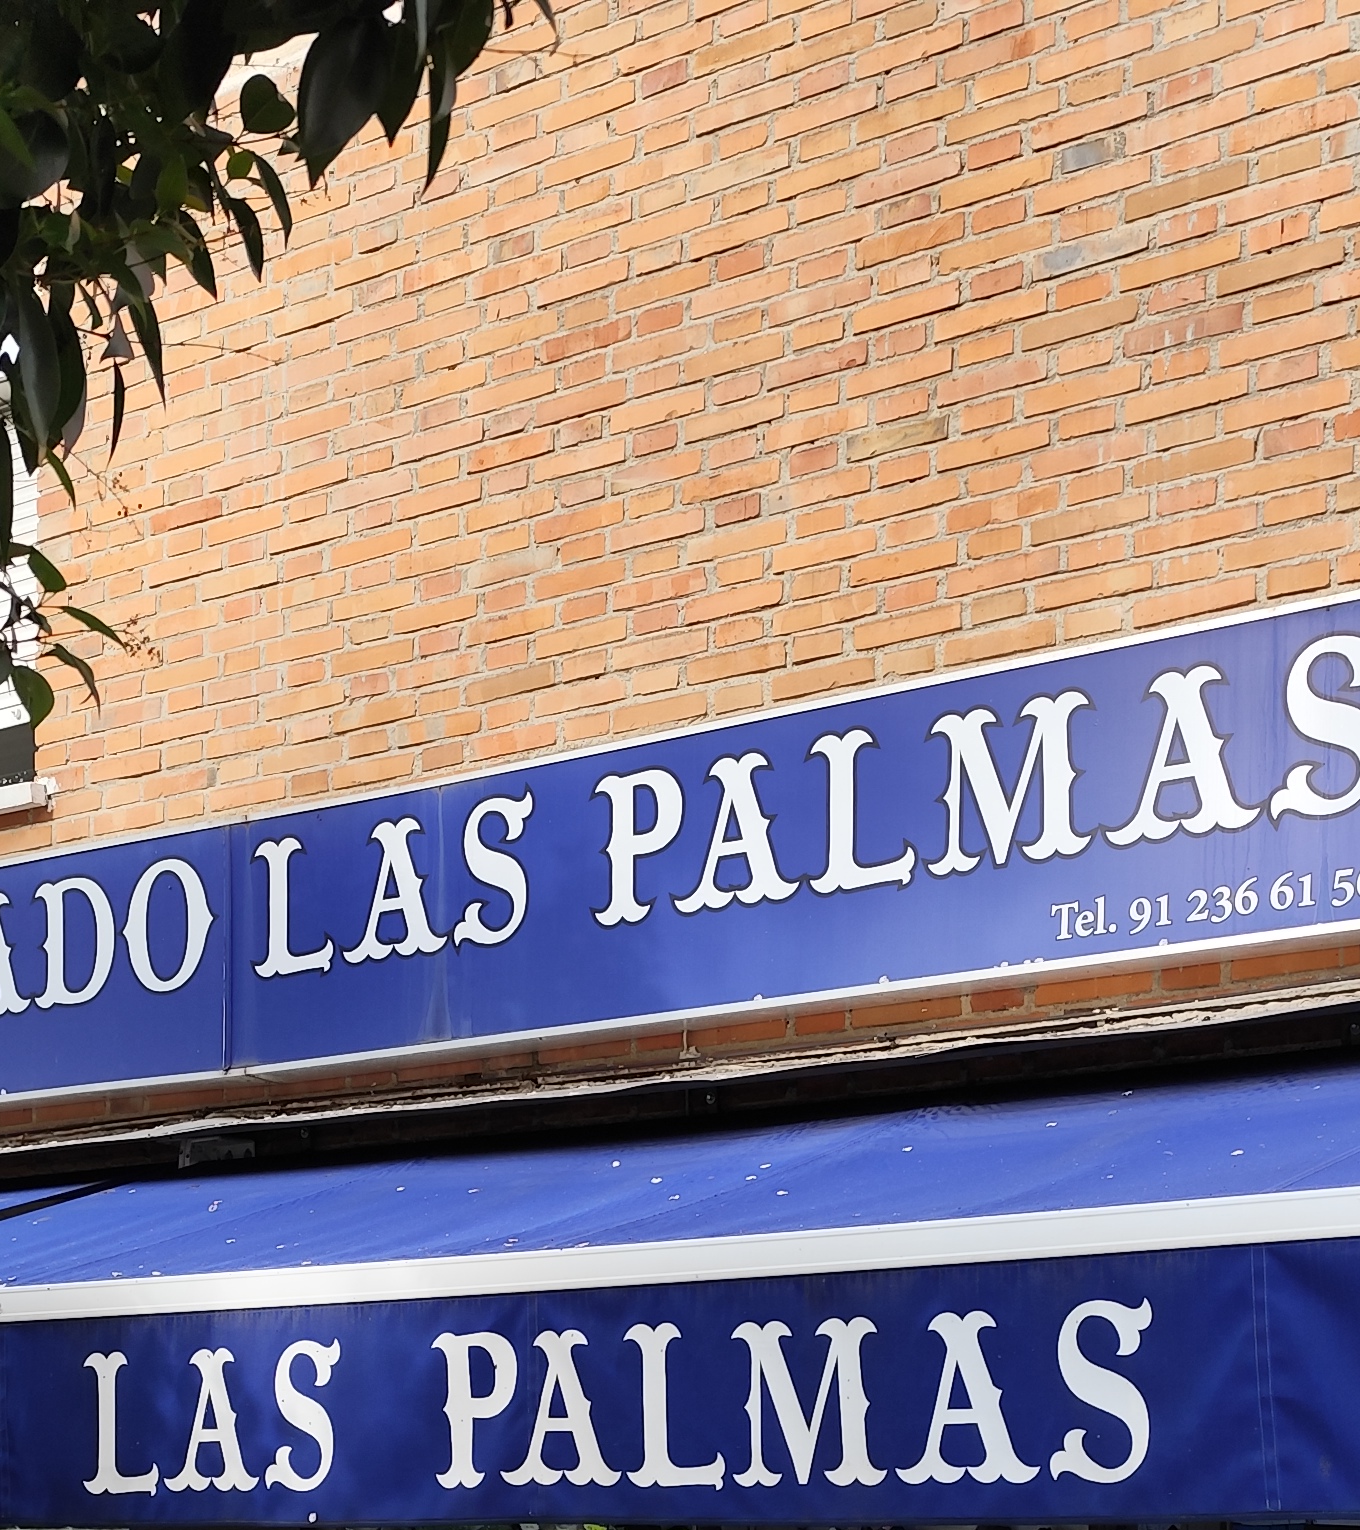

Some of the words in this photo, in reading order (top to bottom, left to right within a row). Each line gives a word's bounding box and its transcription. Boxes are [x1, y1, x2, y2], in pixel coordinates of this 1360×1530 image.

[252, 788, 535, 979] LAS
[1051, 897, 1116, 939] Tel.
[1130, 895, 1171, 934] 91
[1186, 878, 1259, 923] 236
[1268, 870, 1317, 911] 61
[83, 1338, 340, 1496] LAS
[432, 1297, 1153, 1490] PALMAS
